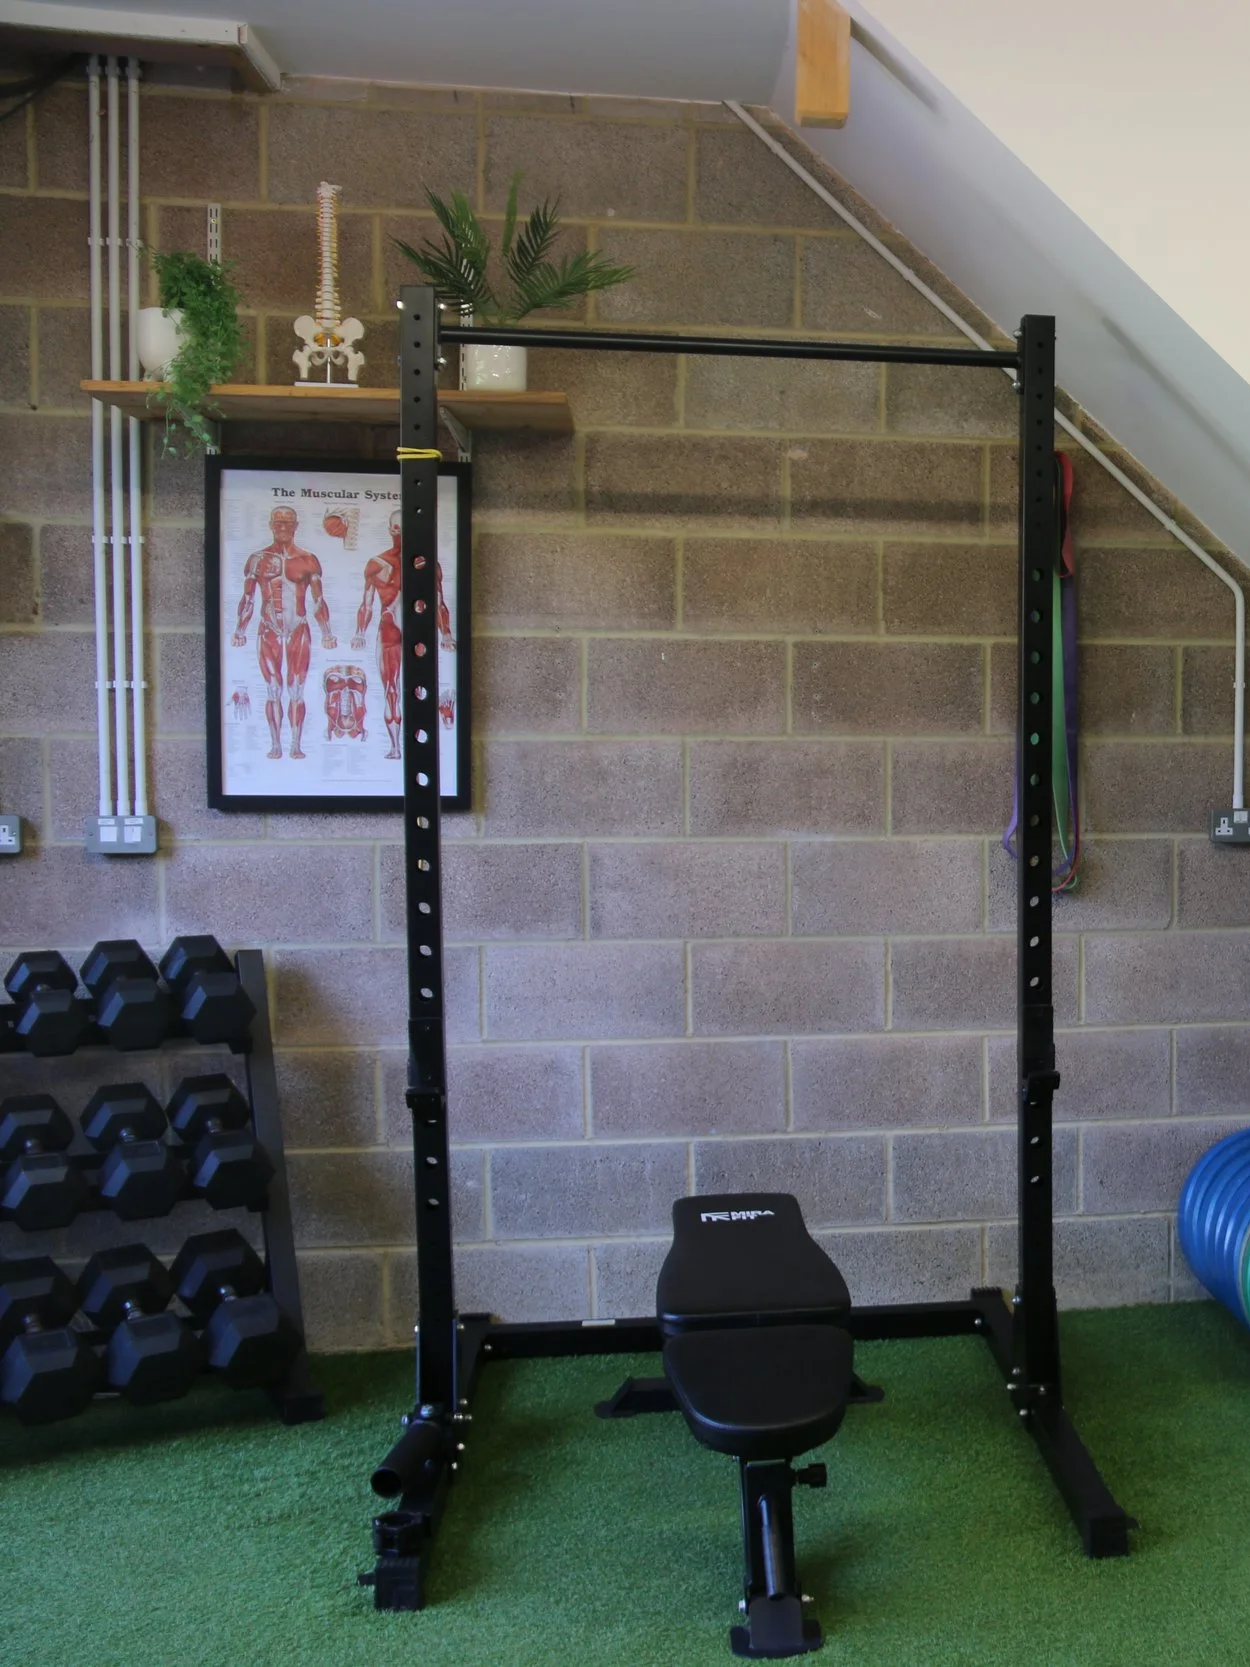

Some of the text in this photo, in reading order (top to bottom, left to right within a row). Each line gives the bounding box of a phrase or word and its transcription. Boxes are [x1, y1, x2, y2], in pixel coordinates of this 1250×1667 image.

[271, 487, 402, 502] The Muscular Syste
